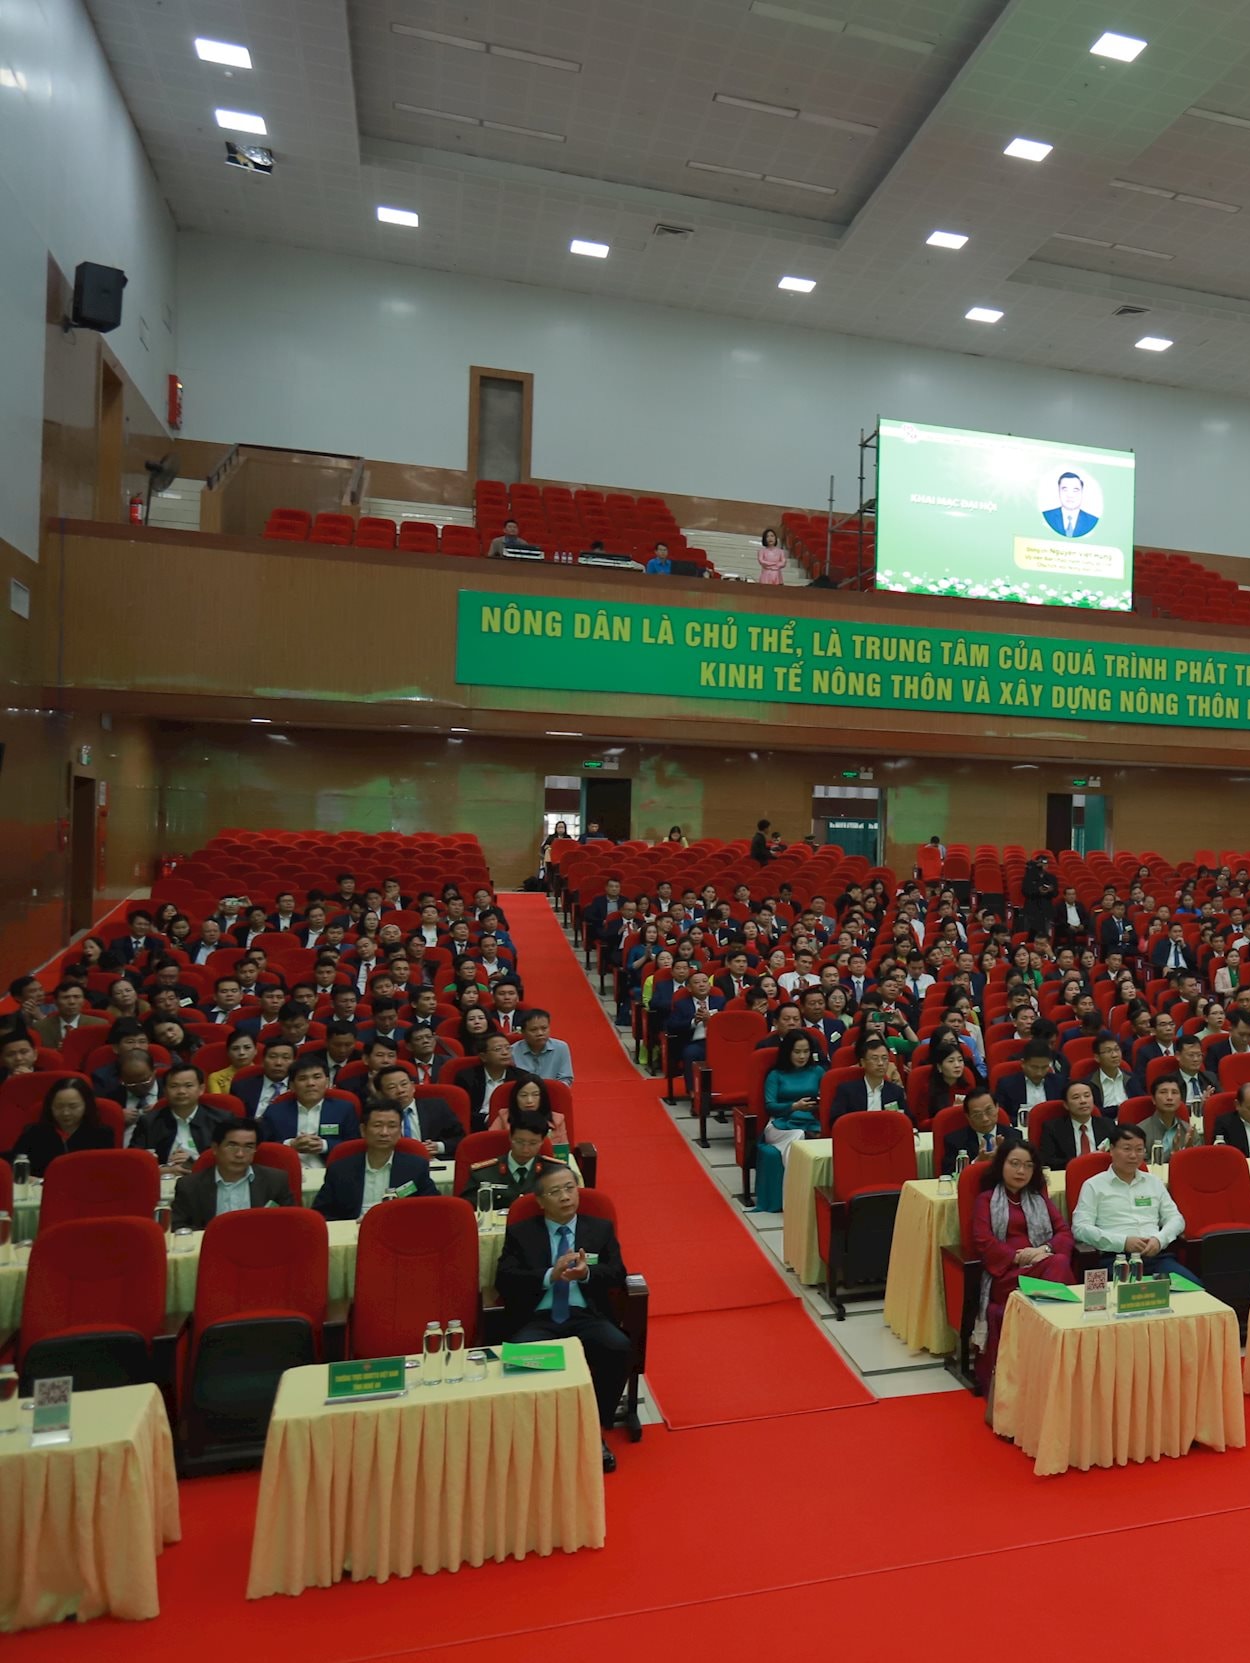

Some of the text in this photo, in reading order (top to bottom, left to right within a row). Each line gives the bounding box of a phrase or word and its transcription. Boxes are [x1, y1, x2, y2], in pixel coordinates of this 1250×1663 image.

[482, 603, 562, 637] NÔNG
[574, 609, 631, 643] DÂN
[642, 613, 675, 646] LÀ
[685, 616, 737, 650] CHỦ
[748, 620, 803, 658] THỂ,
[813, 627, 842, 658] LÀ
[852, 633, 931, 665] TRUNG
[941, 637, 990, 668] TÂM
[998, 640, 1043, 673] CỦA
[1051, 647, 1096, 677] QUÁ
[1104, 653, 1167, 681] TRÌNH
[1175, 656, 1228, 686] PHÁT
[700, 660, 764, 691] KINH
[774, 658, 802, 694] TẾ
[812, 666, 881, 698] NÔNG
[891, 670, 954, 703] THÔN
[961, 677, 990, 705] VÀ
[999, 679, 1042, 709] XÂY
[1051, 683, 1111, 715] DỰNG
[1120, 689, 1178, 717] NÔNG
[1187, 691, 1239, 719] THÔN
